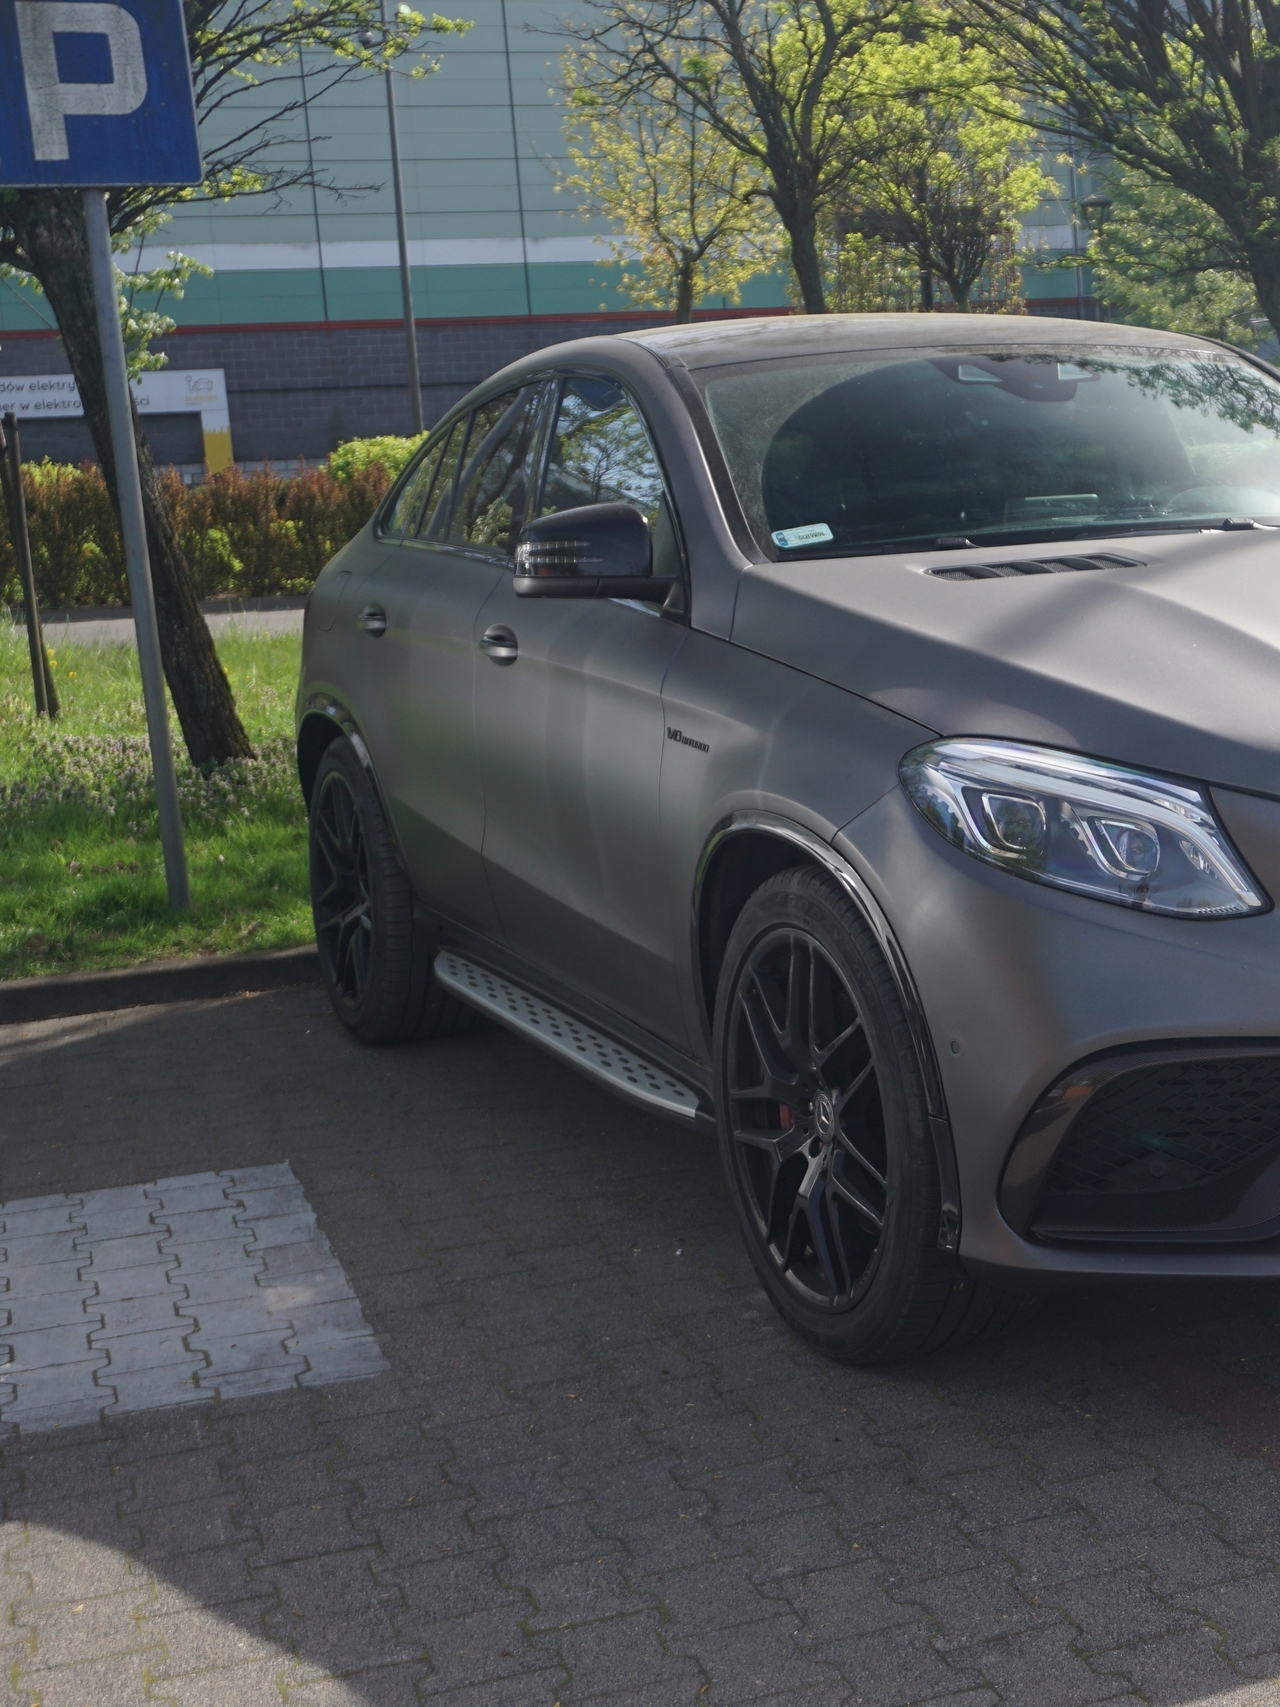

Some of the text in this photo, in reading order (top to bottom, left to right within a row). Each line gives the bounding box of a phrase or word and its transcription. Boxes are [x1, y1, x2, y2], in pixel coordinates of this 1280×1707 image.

[14, 1, 148, 162] P
[29, 379, 76, 392] elektry
[0, 401, 16, 411] er
